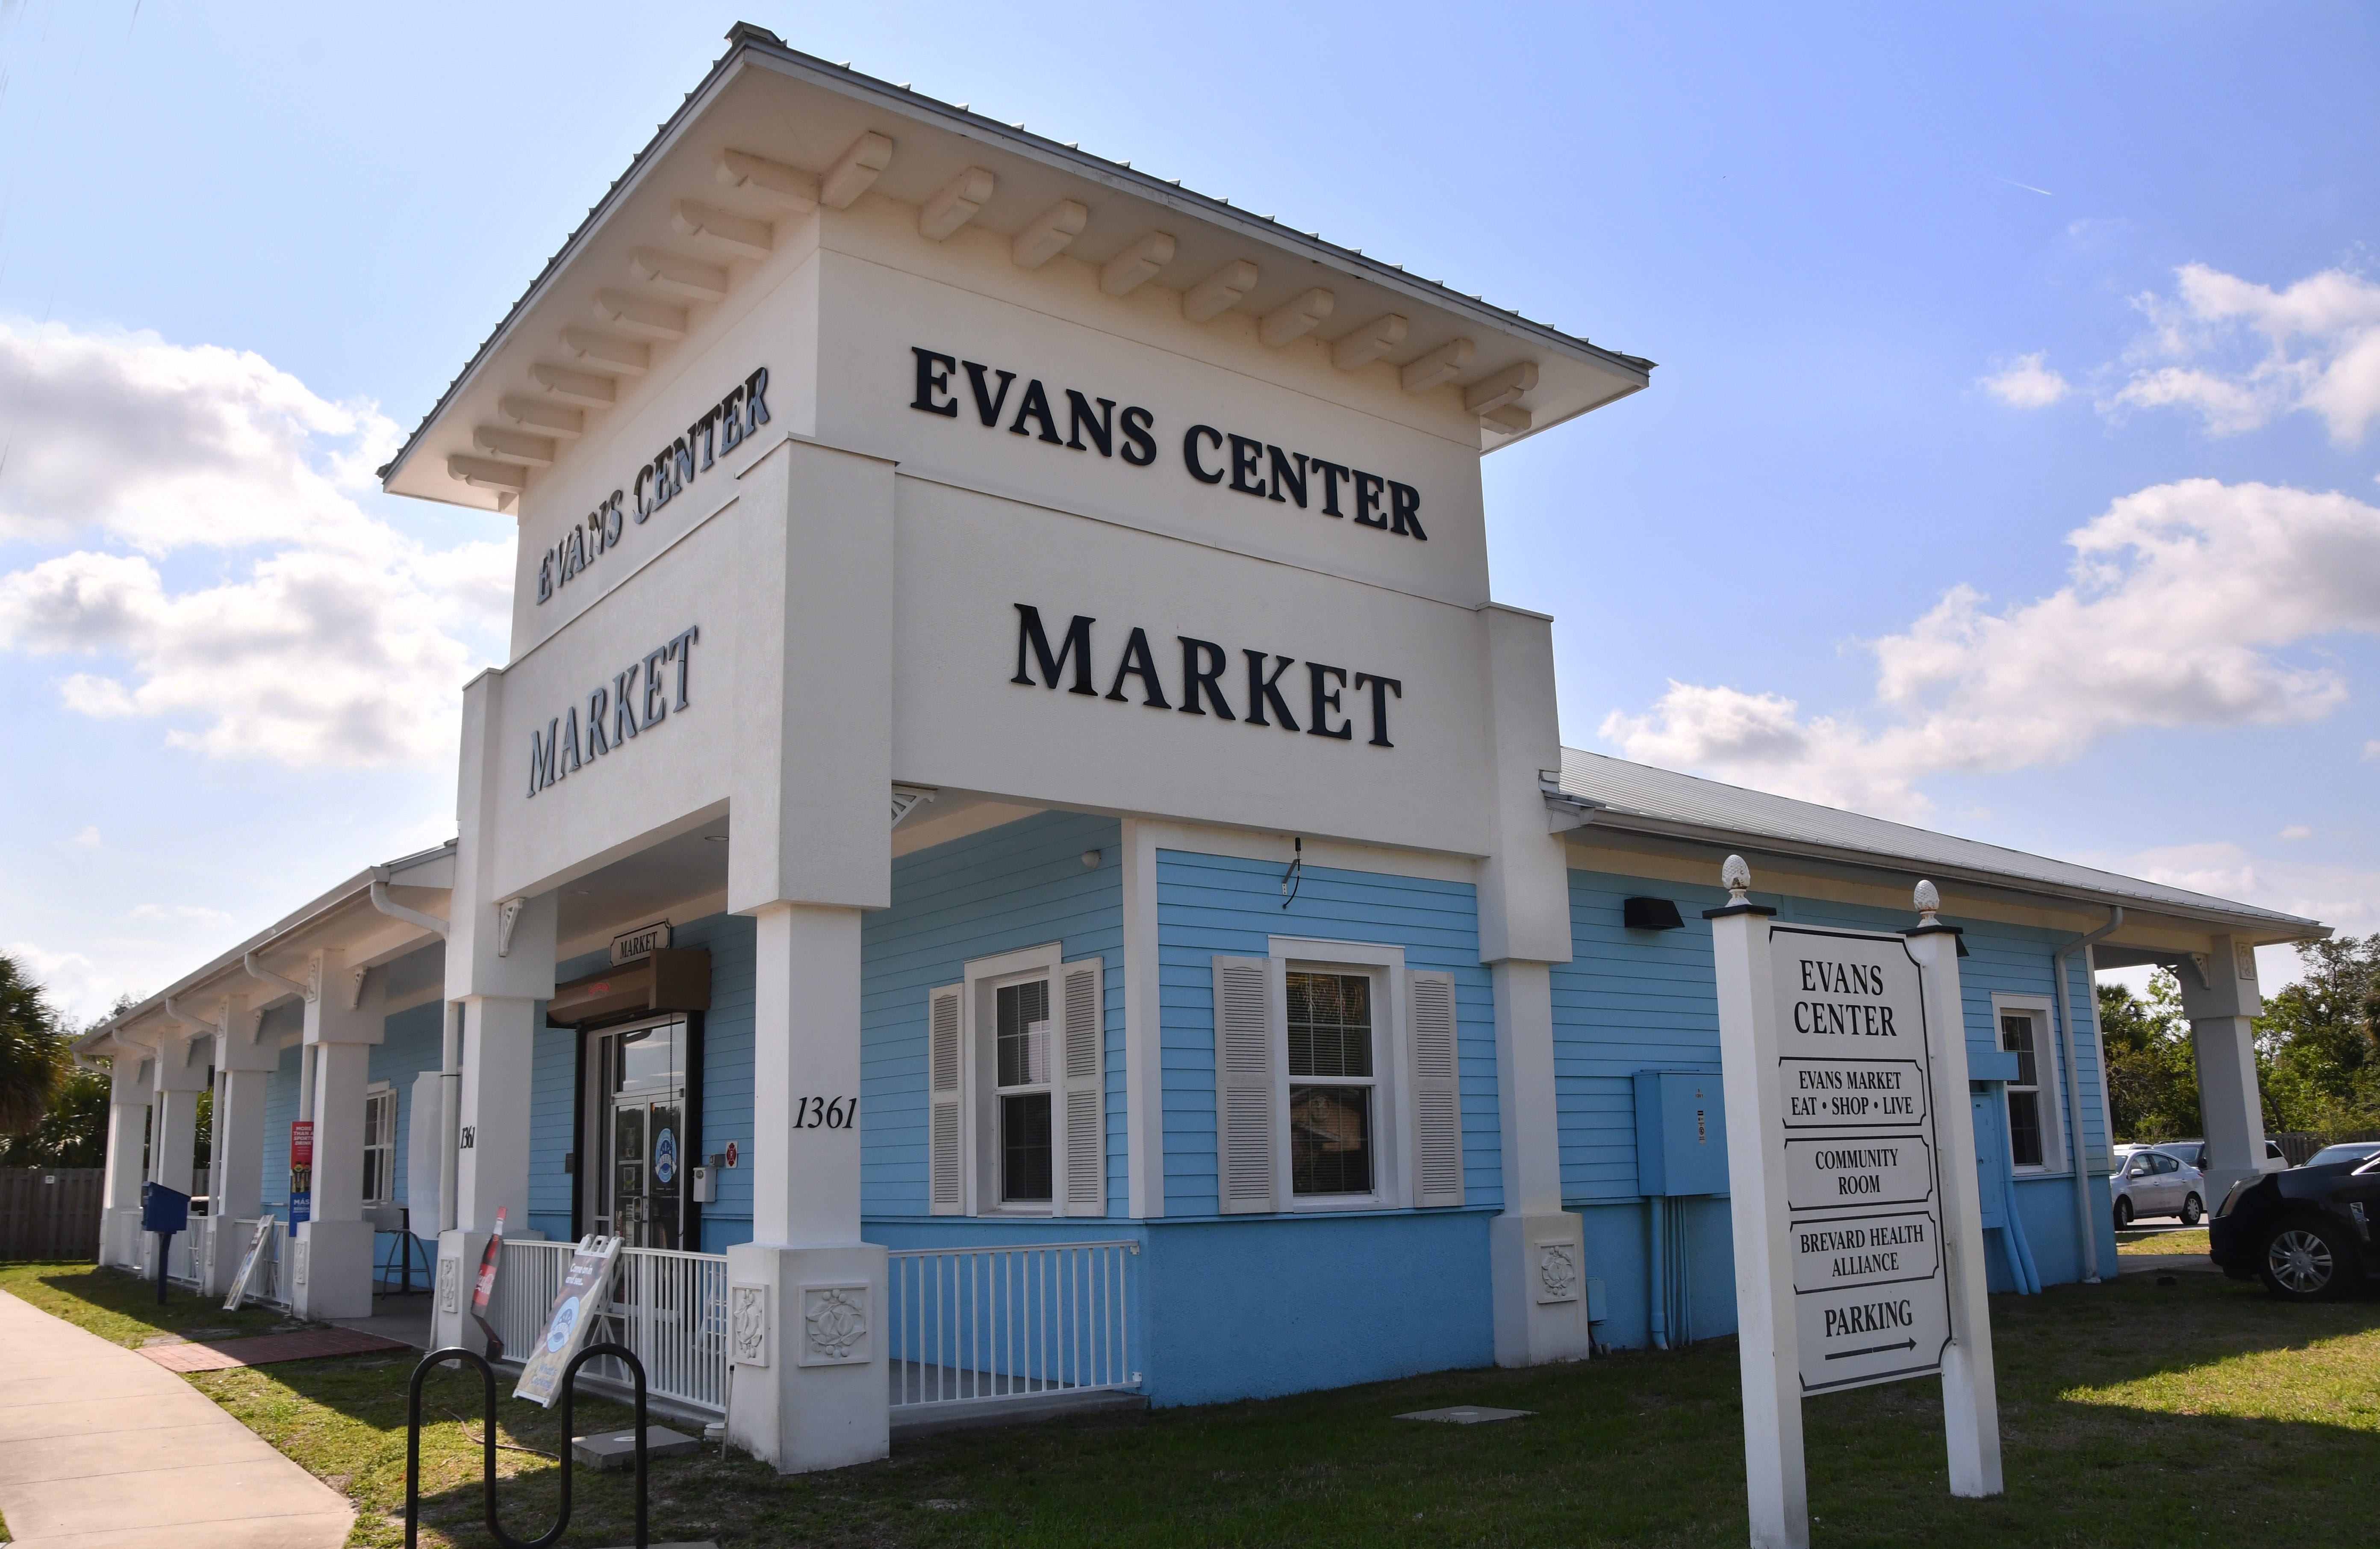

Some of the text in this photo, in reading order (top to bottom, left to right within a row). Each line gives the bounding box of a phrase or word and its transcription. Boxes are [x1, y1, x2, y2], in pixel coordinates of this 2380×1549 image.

[910, 346, 1428, 541] EVANS CENTER
[536, 366, 770, 606] EVANS CENTER
[1010, 603, 1402, 747] MARKET
[526, 625, 699, 799] MARKET
[619, 931, 658, 959] MARKET
[1799, 959, 1883, 996] EVANS
[1794, 1001, 1897, 1037] CENTER
[1799, 1070, 1901, 1089] EVANS MARKET
[792, 1095, 857, 1129] 1361
[1791, 1096, 1913, 1115] EAT SHOP LIVE
[460, 1125, 475, 1149] 1361
[1815, 1148, 1898, 1170] COMMUNITY
[1838, 1174, 1881, 1195] ROOM
[1800, 1224, 1924, 1254] BREVARD HEALTH
[1832, 1252, 1899, 1277] ALLIANCE
[1824, 1299, 1913, 1337] PARKING
